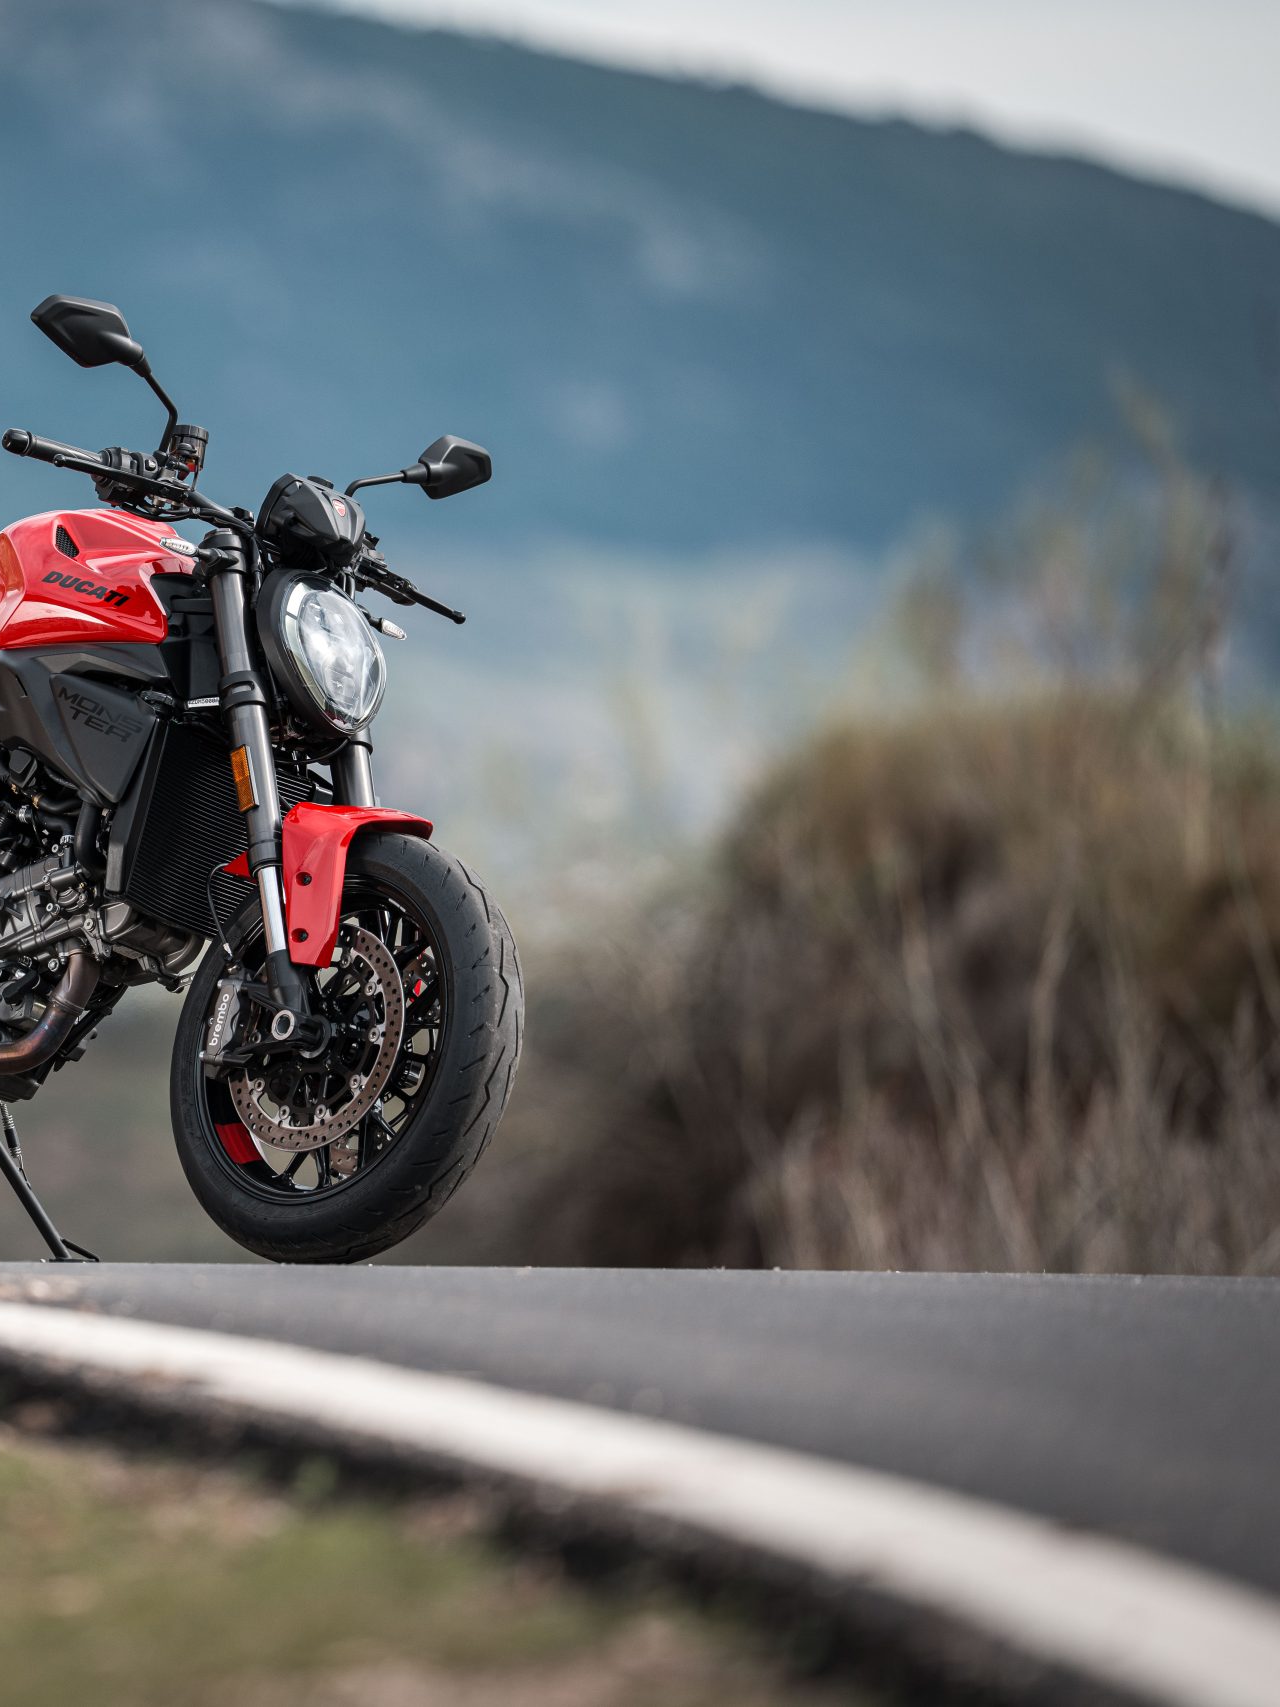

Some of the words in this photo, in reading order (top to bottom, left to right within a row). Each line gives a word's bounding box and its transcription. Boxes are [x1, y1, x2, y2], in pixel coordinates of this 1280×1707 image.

[42, 571, 129, 606] DUCATI
[59, 687, 143, 733] MONS
[70, 706, 132, 742] TER
[209, 993, 229, 1046] brembo
